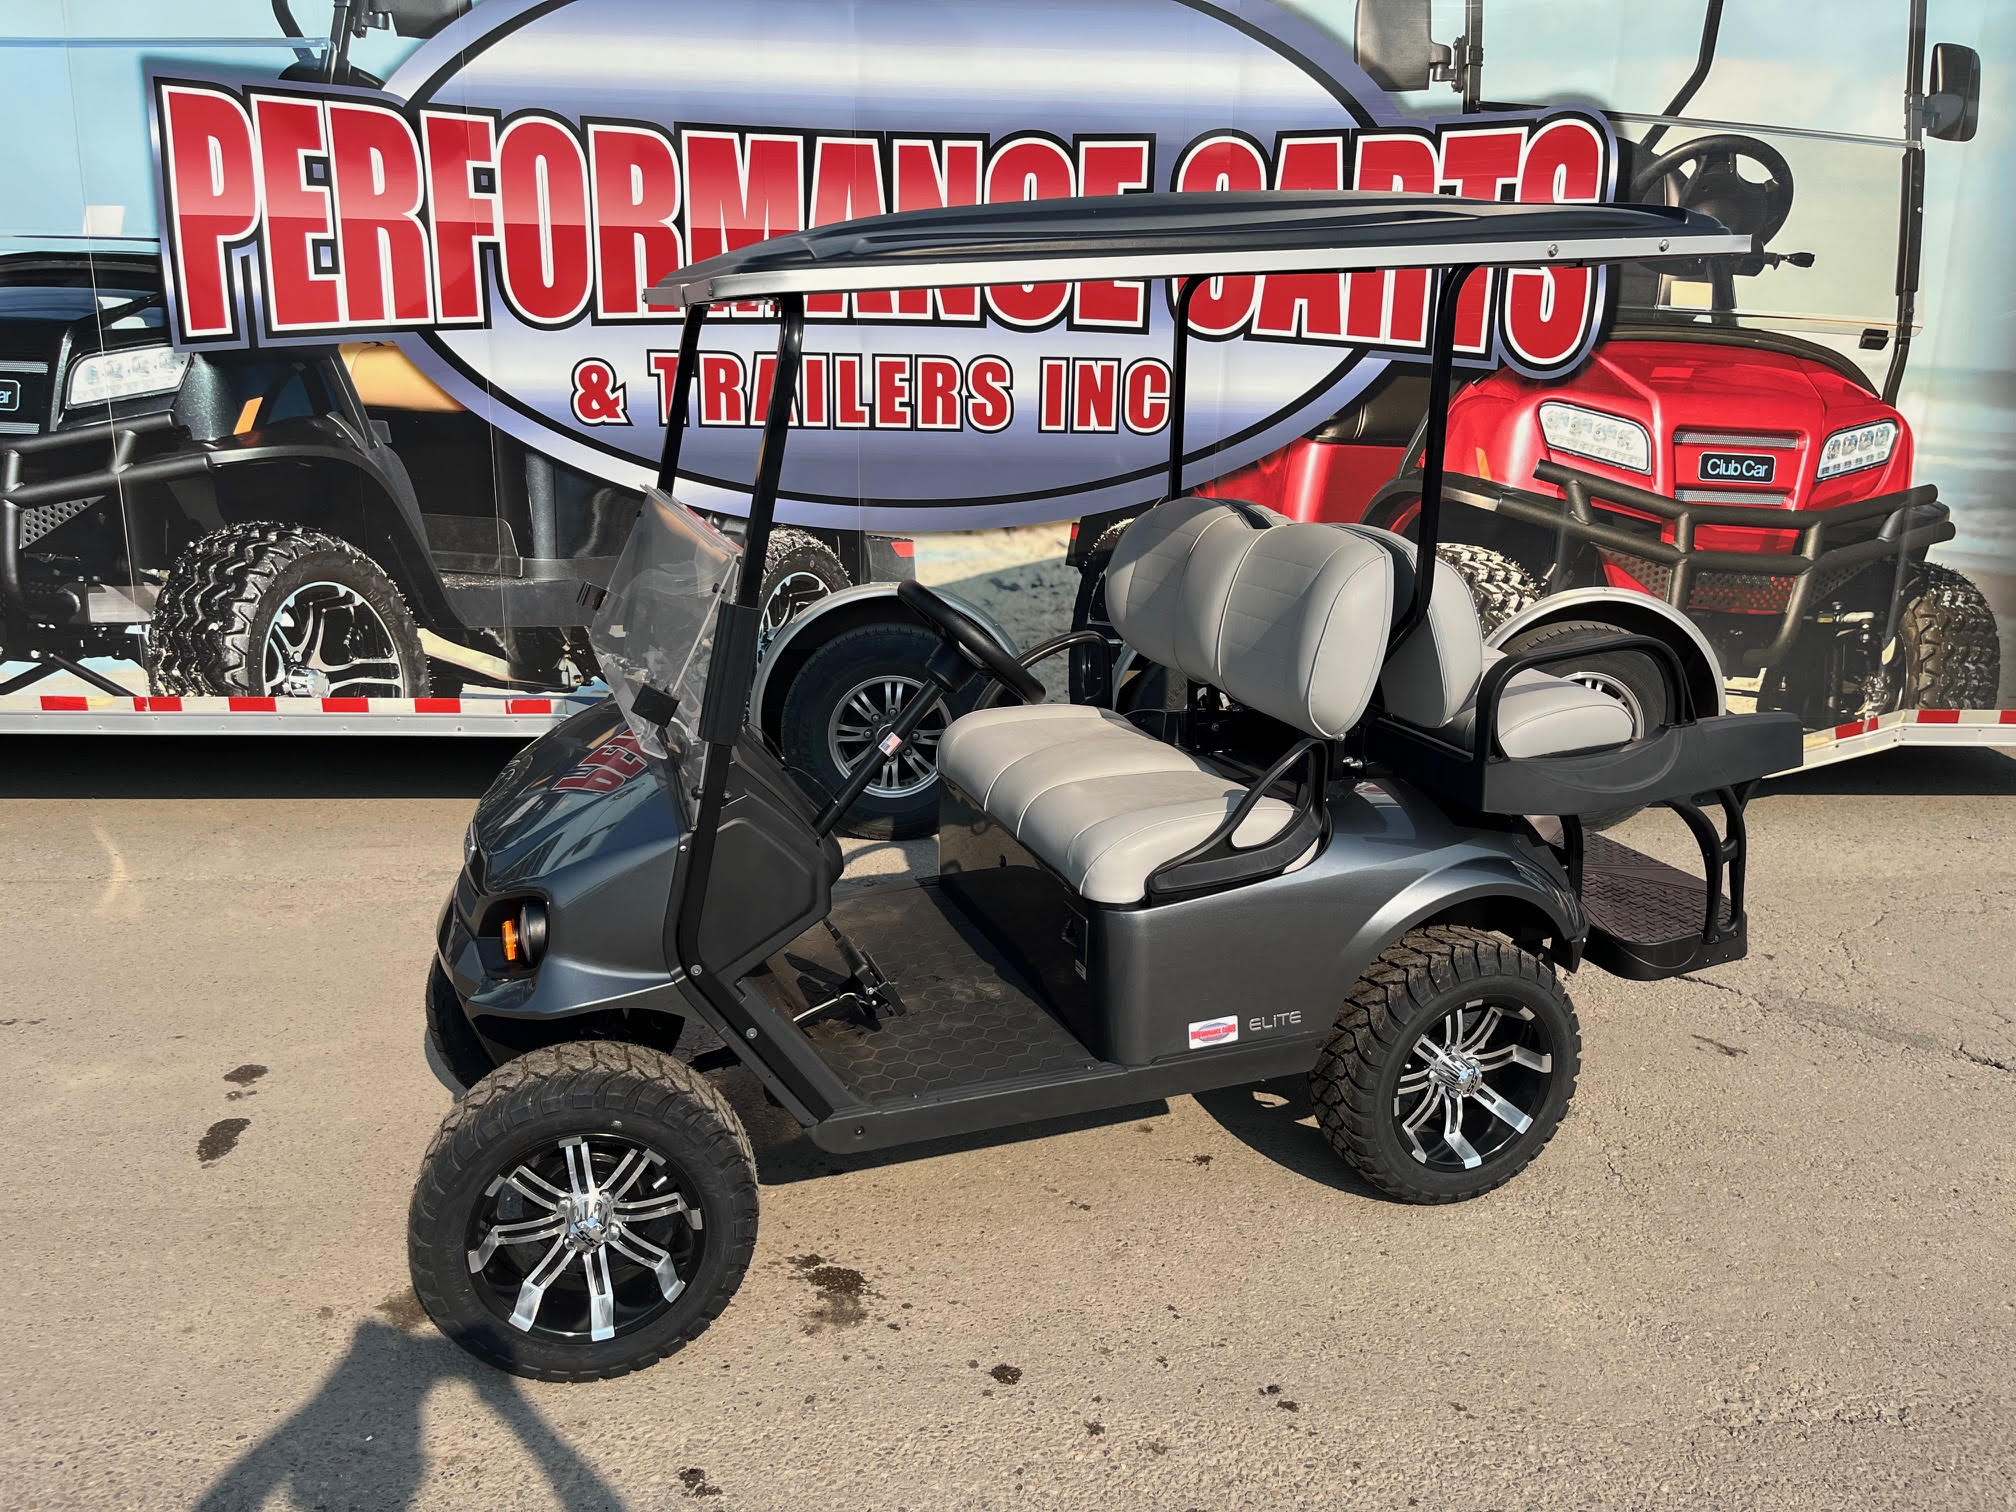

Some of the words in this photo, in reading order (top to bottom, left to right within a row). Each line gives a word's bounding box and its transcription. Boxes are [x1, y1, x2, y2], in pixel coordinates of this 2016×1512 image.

[572, 360, 629, 425] &
[648, 351, 905, 434] TRAILERS
[1039, 356, 1172, 436] INC
[1707, 458, 1741, 476] Club
[1742, 460, 1769, 478] Car
